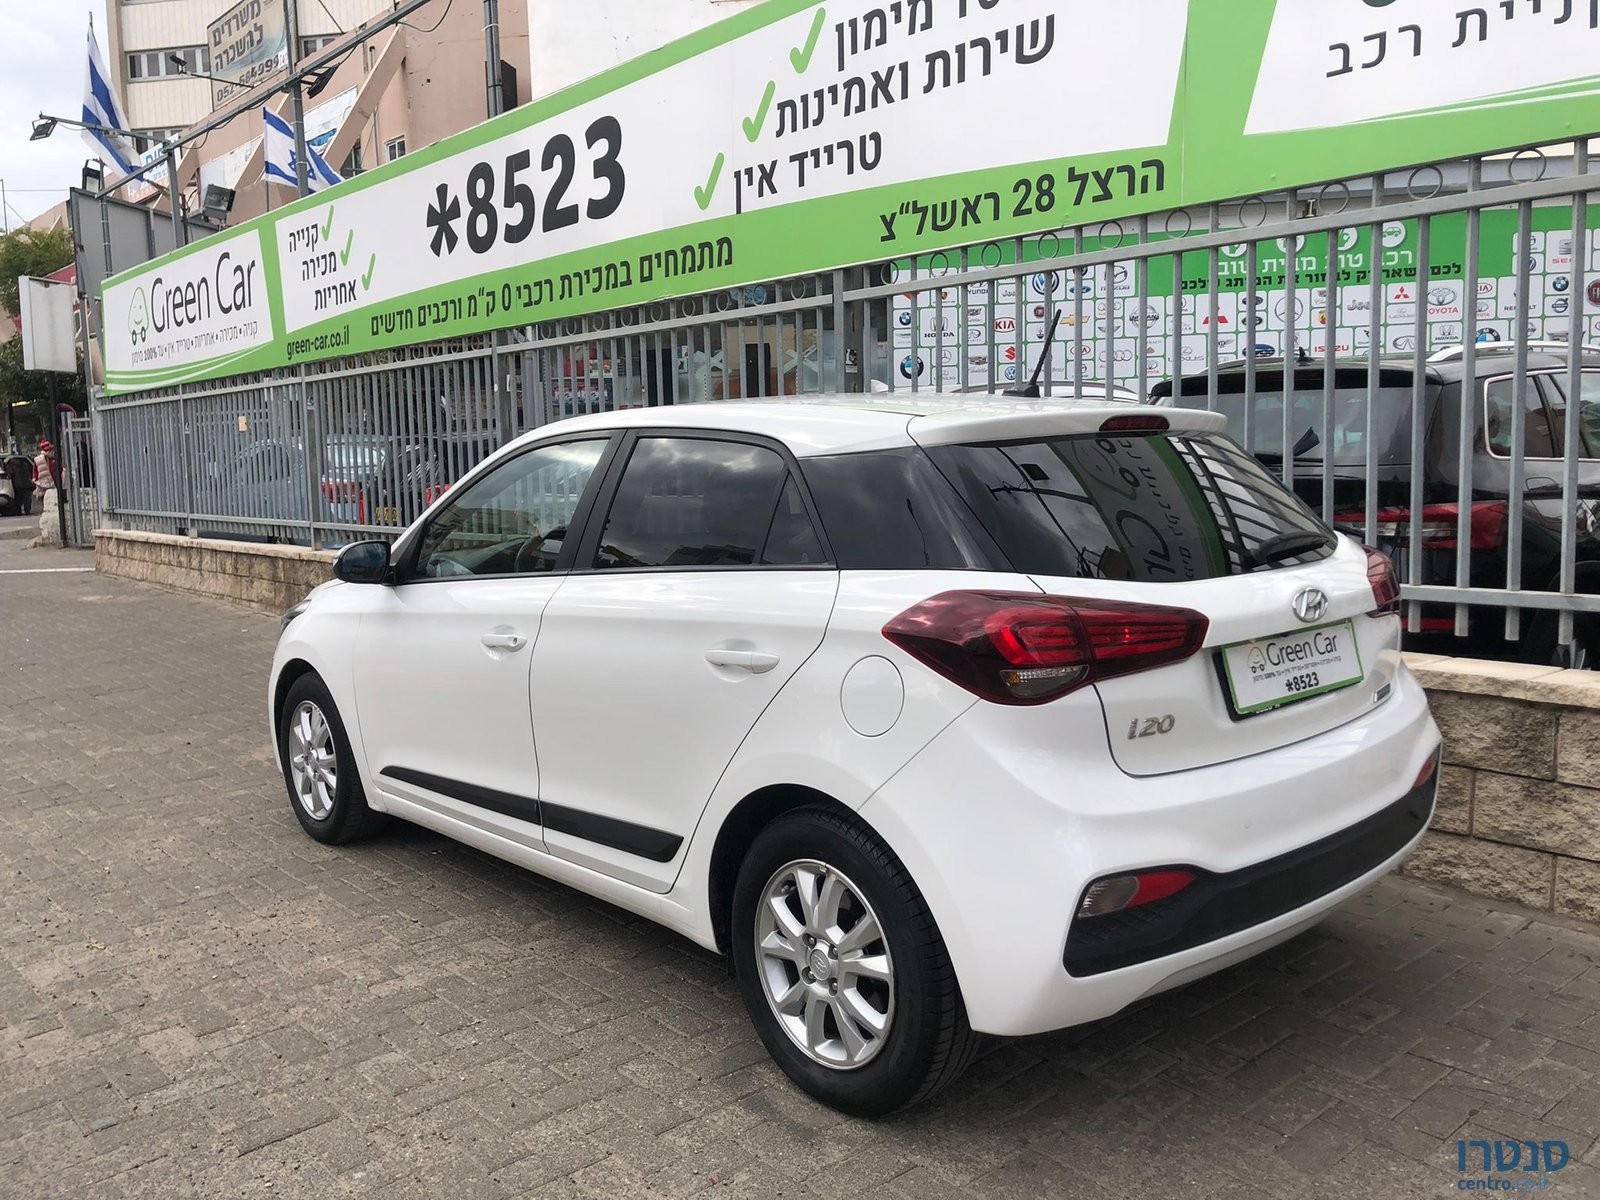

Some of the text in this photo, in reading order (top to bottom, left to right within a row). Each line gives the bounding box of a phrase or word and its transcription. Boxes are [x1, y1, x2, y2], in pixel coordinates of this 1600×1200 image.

[212, 0, 261, 47] משרדים
[214, 22, 263, 72] להשכרה
[1326, 24, 1422, 78] רכב
[775, 14, 1055, 138] שירות ואמינות
[733, 131, 882, 215] טרייד אין
[1067, 158, 1165, 206] הרצל
[1012, 173, 1055, 217] 28
[289, 223, 319, 253] קנייה
[302, 251, 337, 281] מכירה
[639, 236, 733, 284] מתמחים
[151, 252, 256, 333] Green Car
[314, 279, 357, 311] אחריות
[502, 283, 512, 312] 0
[516, 278, 554, 308] רכבי
[559, 260, 633, 301] במכירת
[371, 307, 413, 337] חדשים
[418, 297, 462, 327] ורכבים
[995, 320, 1015, 330] KIA
[1427, 306, 1459, 315] OYOTA
[243, 321, 258, 340] קניה
[286, 324, 350, 361] green-car.co.il
[1314, 344, 1349, 353] ISZU
[1266, 632, 1338, 666] Green Car
